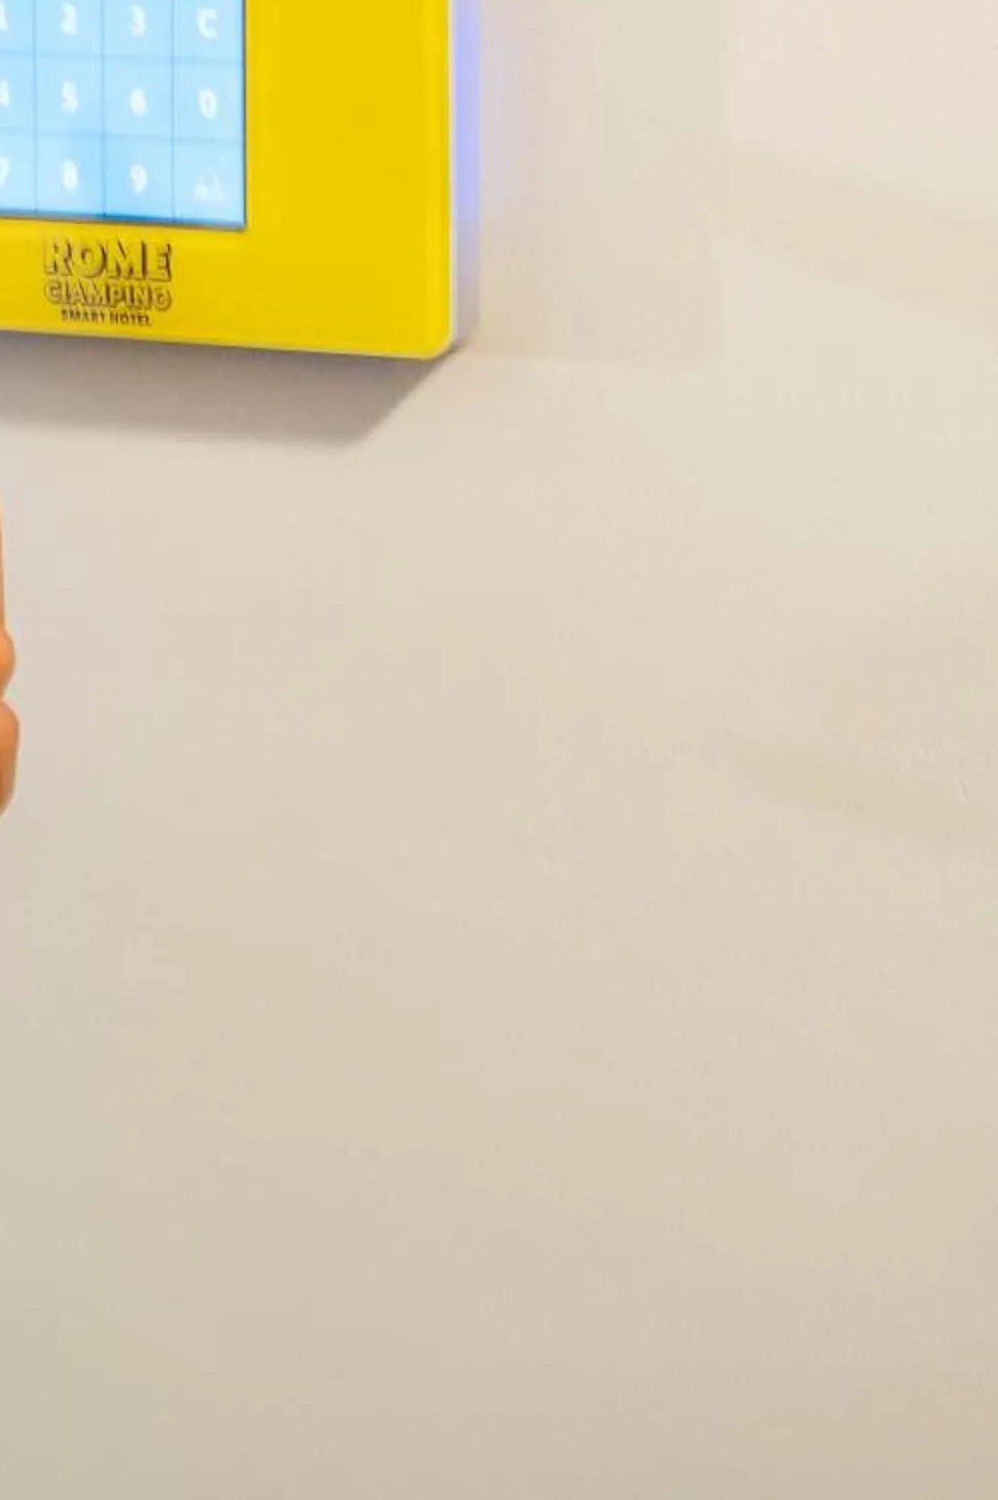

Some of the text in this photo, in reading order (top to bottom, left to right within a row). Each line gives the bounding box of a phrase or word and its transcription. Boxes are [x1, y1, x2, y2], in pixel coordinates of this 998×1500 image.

[60, 3, 77, 35] 2
[130, 4, 147, 38] 3
[197, 7, 219, 40] C
[61, 80, 79, 113] 5
[130, 88, 147, 117] 6
[61, 159, 79, 194] 8
[130, 163, 148, 195] 9
[43, 235, 173, 282] ROME
[44, 279, 174, 311] CIAMPINO
[60, 307, 153, 327] SMART HOTEL
